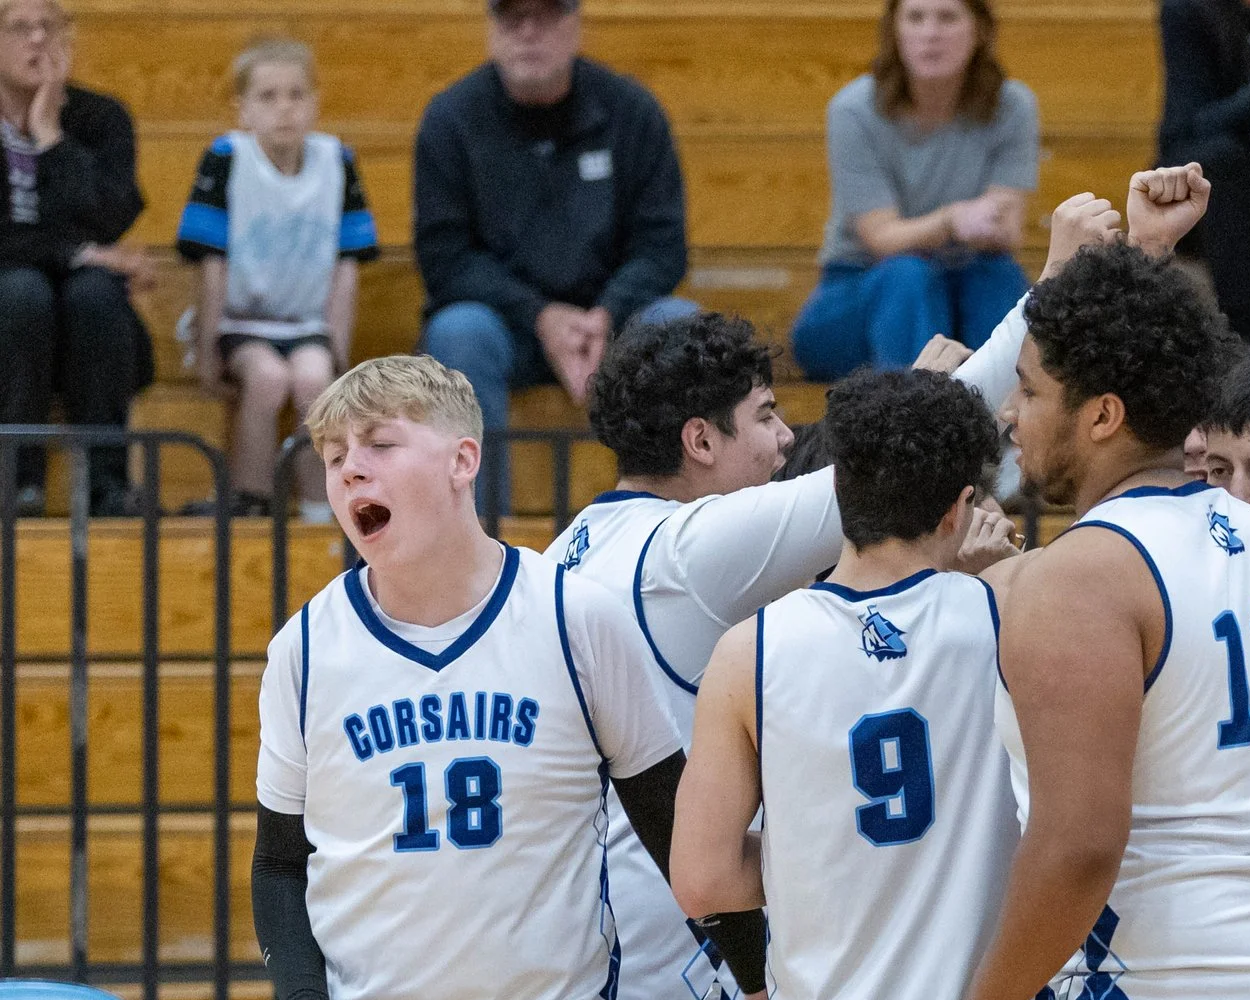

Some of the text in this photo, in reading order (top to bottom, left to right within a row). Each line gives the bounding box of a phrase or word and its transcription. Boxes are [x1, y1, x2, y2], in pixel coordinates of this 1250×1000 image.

[343, 691, 540, 762] CORSAIRS
[390, 756, 503, 852] 18
[848, 707, 936, 847] 9
